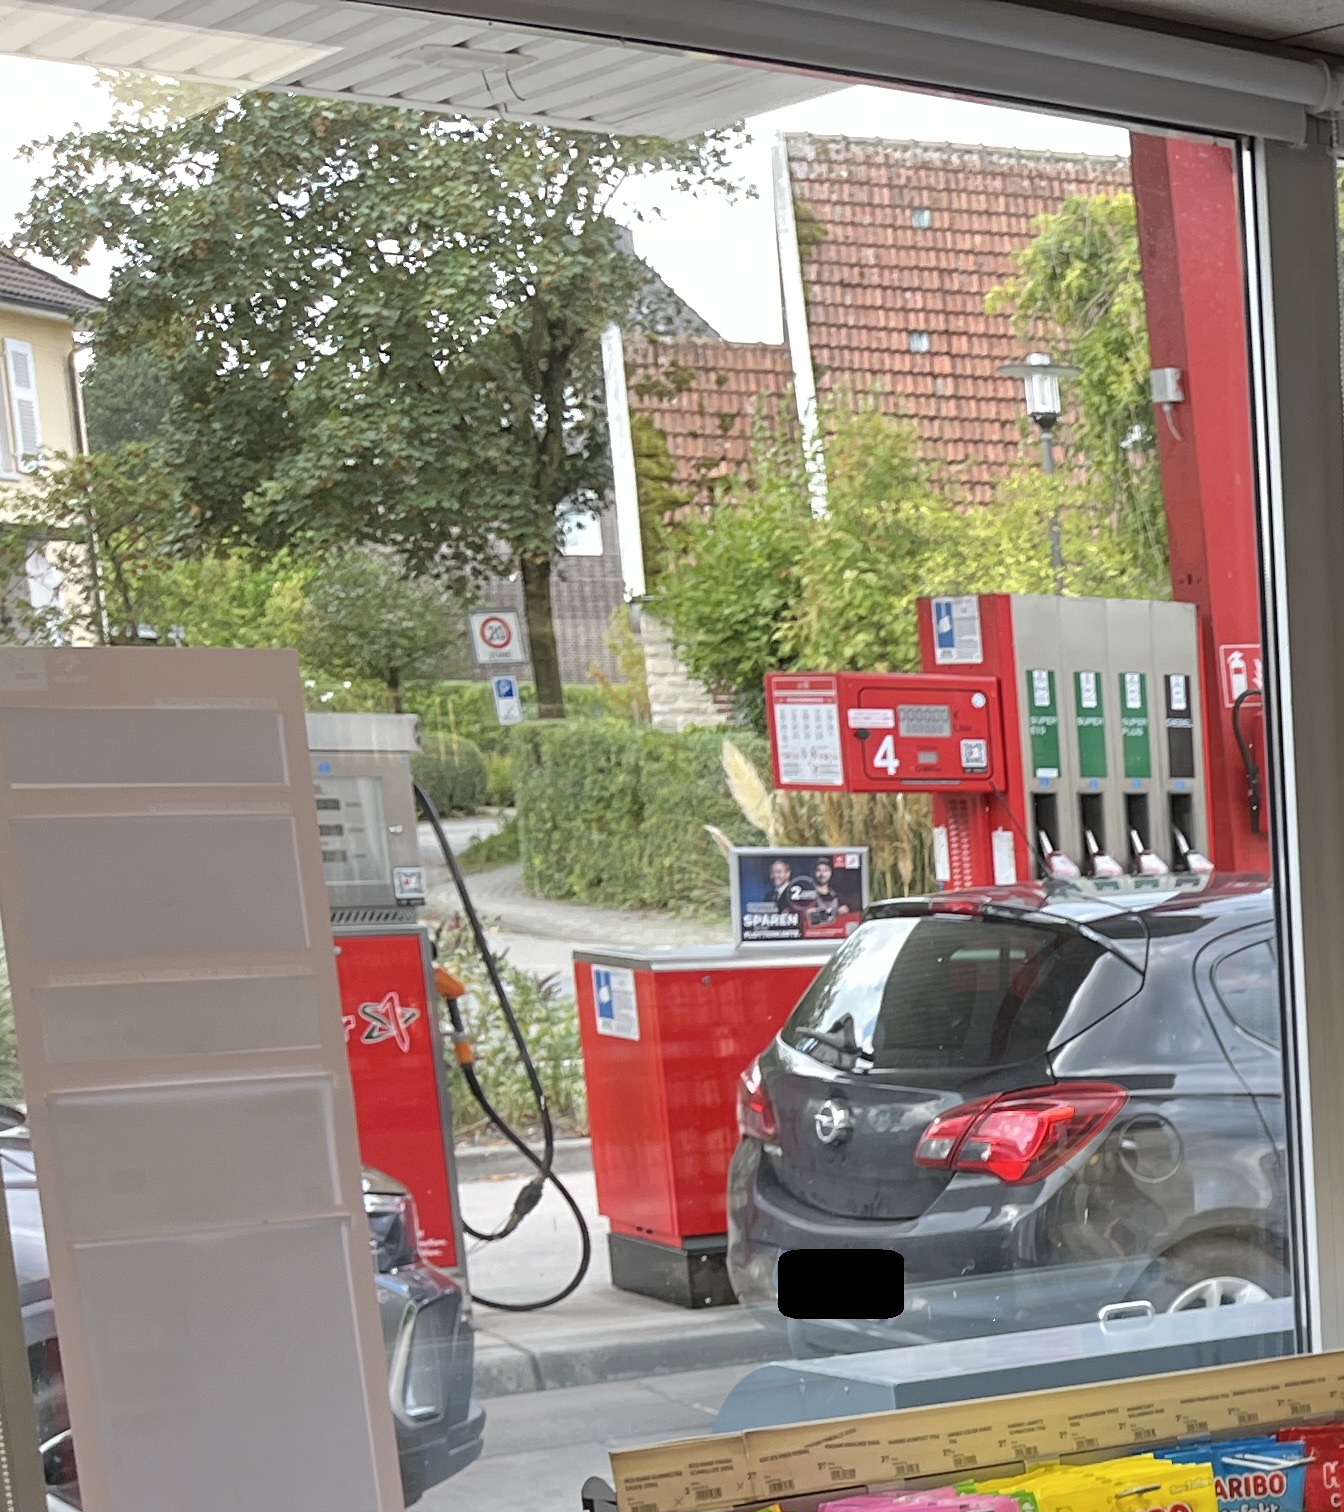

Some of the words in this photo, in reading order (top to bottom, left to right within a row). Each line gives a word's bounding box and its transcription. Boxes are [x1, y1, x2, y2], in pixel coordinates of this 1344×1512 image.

[873, 734, 900, 776] 4
[743, 913, 799, 928] SPAREN
[1214, 1471, 1286, 1500] ARIBO
